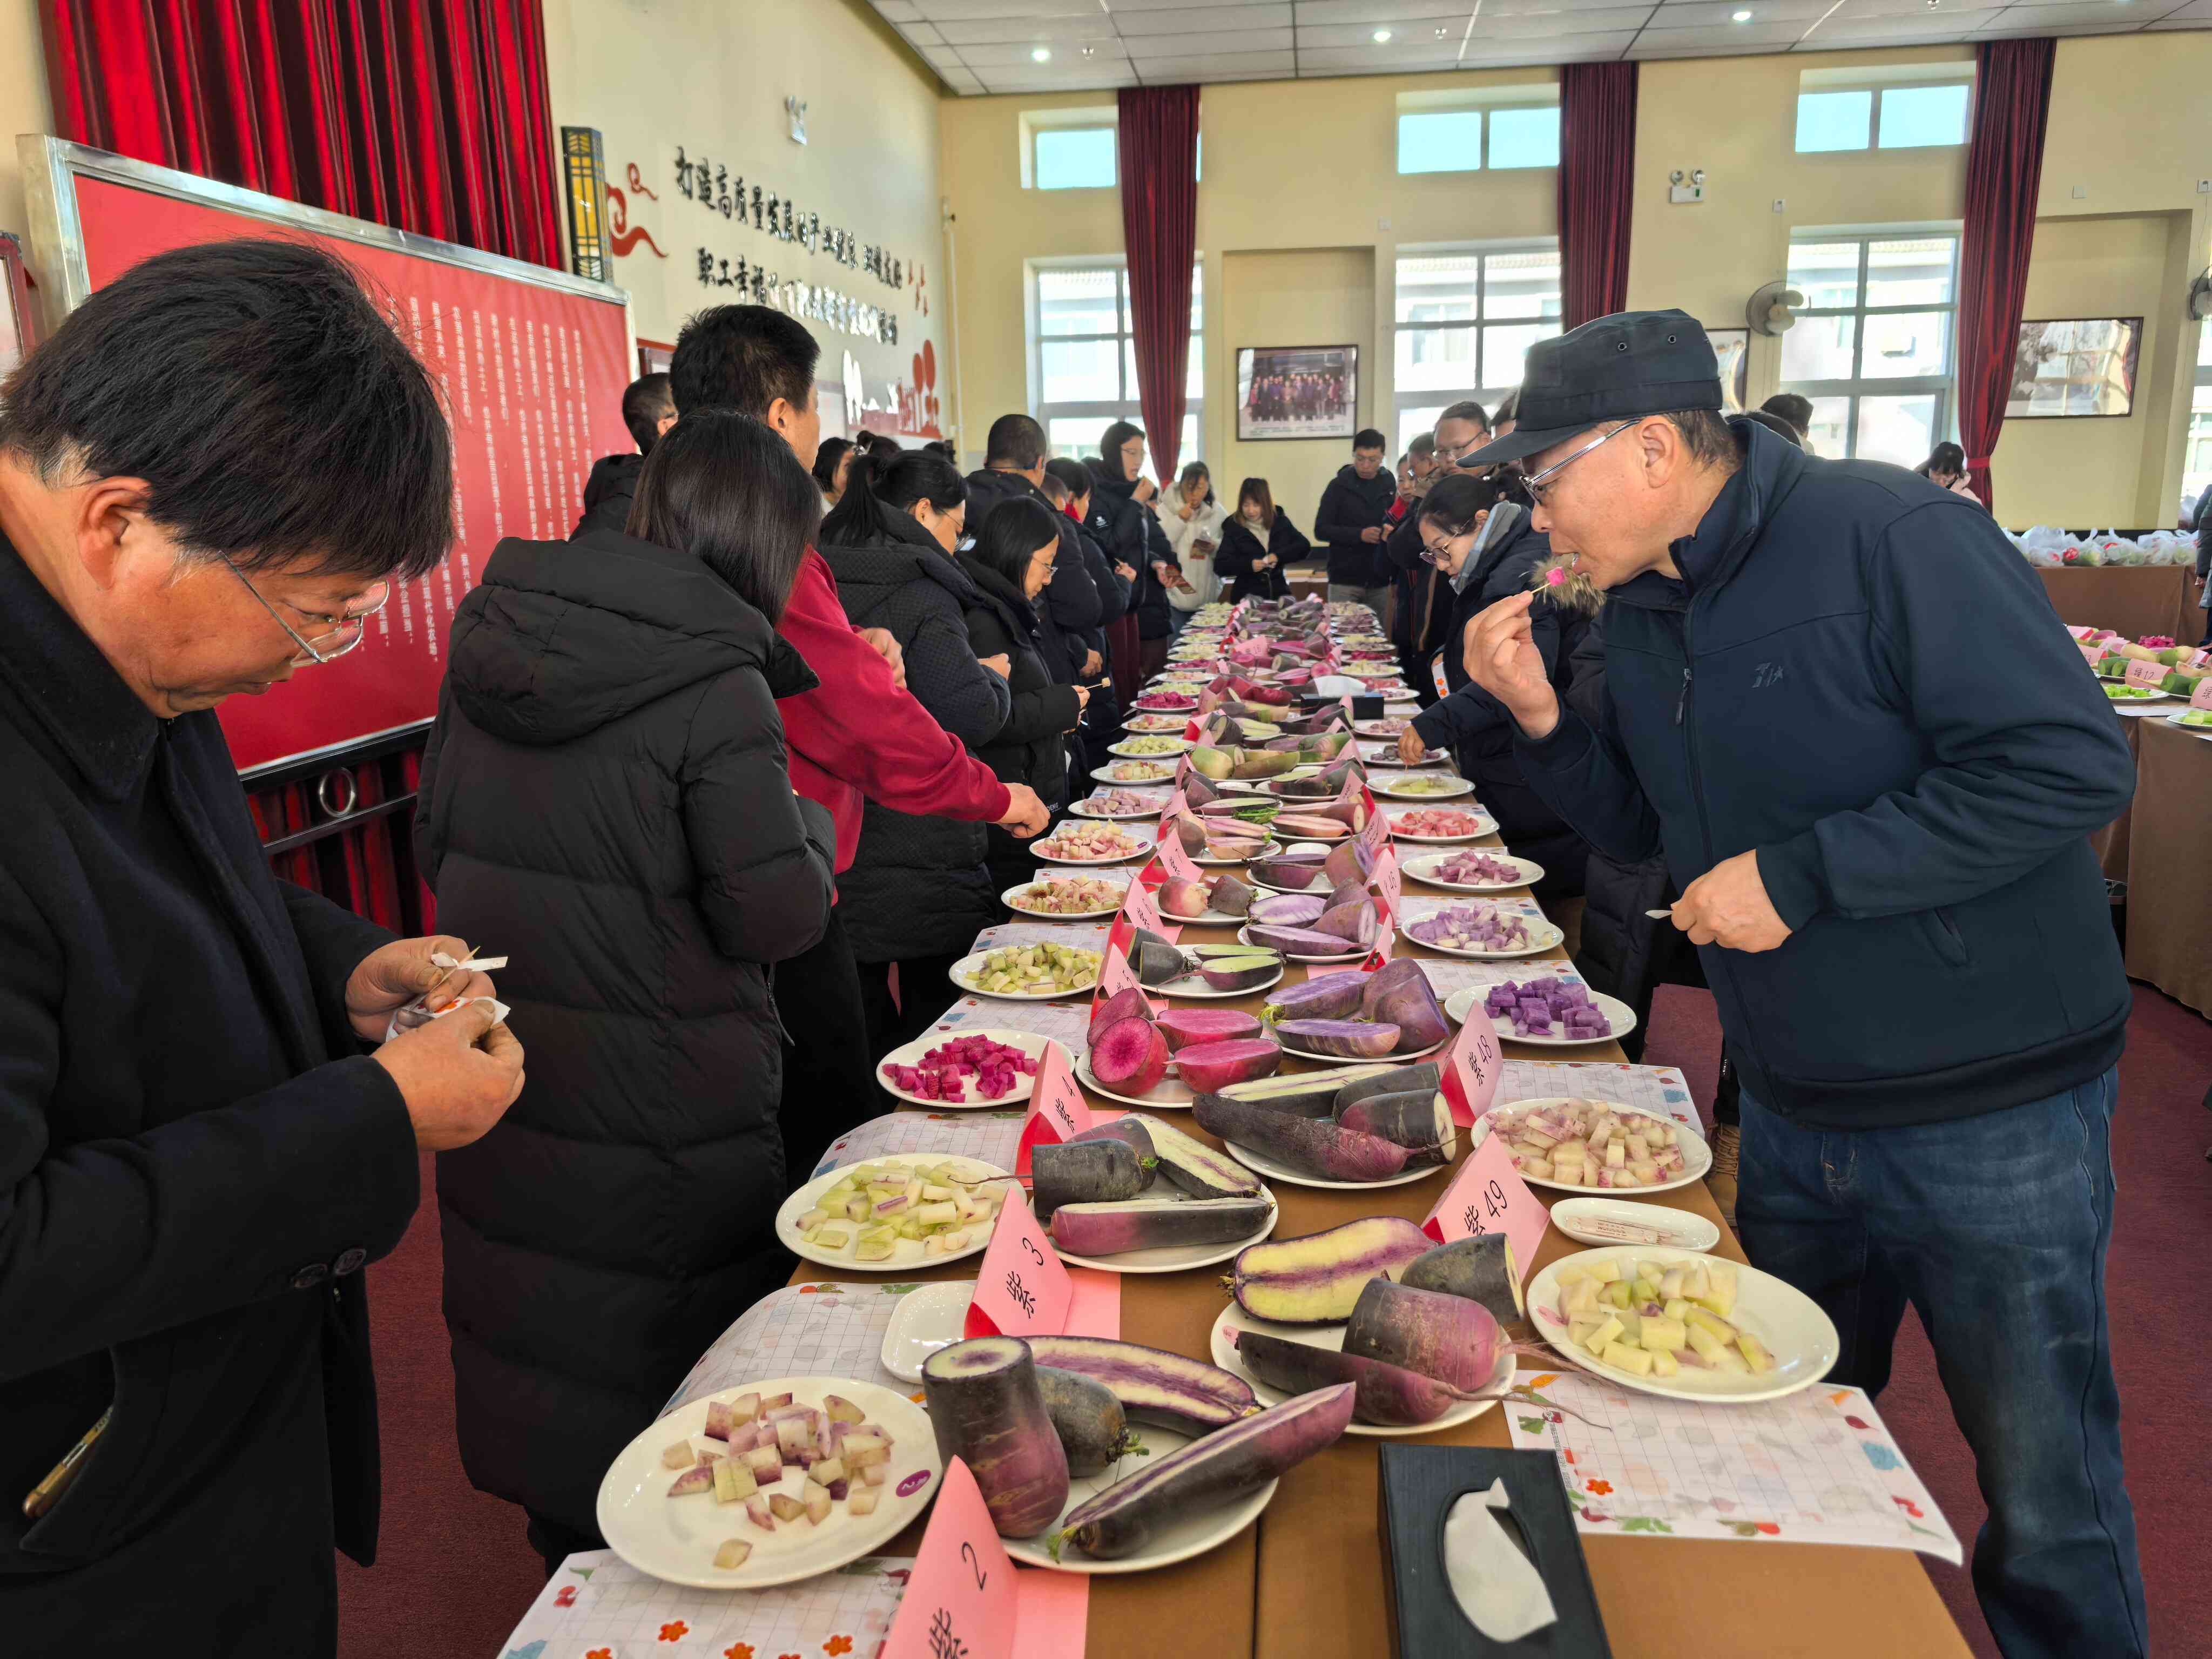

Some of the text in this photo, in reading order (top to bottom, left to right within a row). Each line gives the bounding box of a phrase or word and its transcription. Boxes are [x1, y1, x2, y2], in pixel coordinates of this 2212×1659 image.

[1468, 1034, 1492, 1087] 紫 48
[1055, 1075, 1076, 1134] 紫 4
[1483, 1179, 1508, 1218] 49
[1006, 1237, 1044, 1319] 紫 3
[961, 1541, 987, 1591] 2
